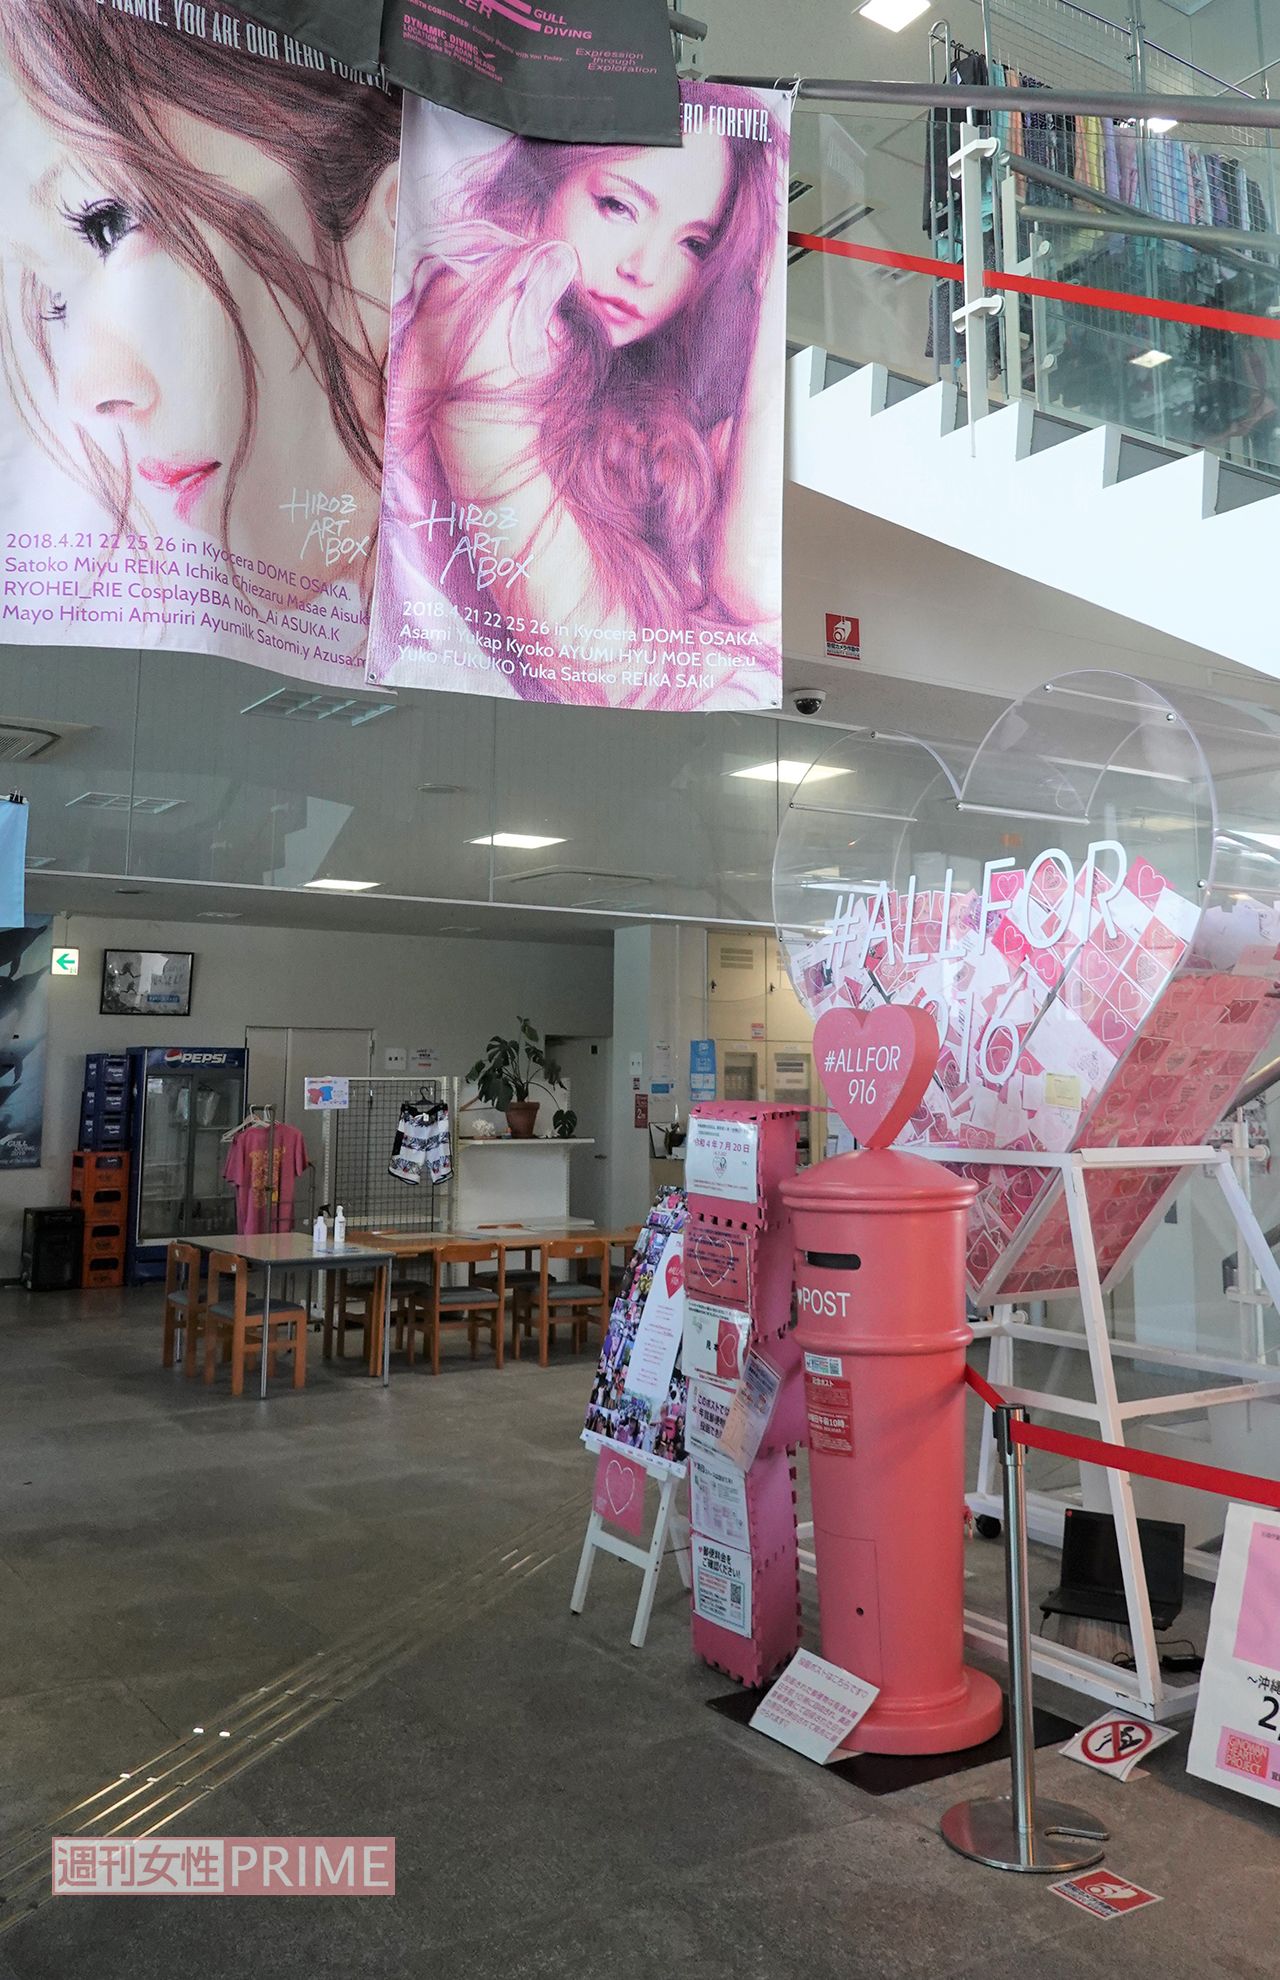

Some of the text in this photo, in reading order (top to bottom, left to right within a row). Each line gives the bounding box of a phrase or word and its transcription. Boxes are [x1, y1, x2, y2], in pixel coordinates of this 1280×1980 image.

[174, 0, 206, 38] YOU
[212, 12, 241, 49] ARE
[246, 23, 279, 60] OUR
[533, 8, 567, 25] GULL
[543, 25, 593, 40] DIVING
[403, 24, 438, 43] LOCATION
[403, 14, 479, 55] DYNAMIC DIVING
[575, 48, 644, 60] Expression
[587, 63, 658, 74] Exploration
[592, 57, 637, 66] through
[709, 105, 773, 142] FOREVER.
[300, 519, 350, 560] ART
[325, 536, 370, 567] BOX
[6, 533, 351, 601] 2018.4.21 22 25 26 in Kyocera DOME OSAKA.
[440, 533, 509, 584] ART
[476, 556, 532, 591] BOX
[5, 557, 69, 573] Satoko
[74, 557, 118, 577] Miyu
[125, 558, 180, 576] REIKA
[186, 562, 229, 586] Ichika
[232, 574, 284, 605] Chiezaru
[287, 593, 327, 617] Masae
[4, 581, 340, 642] RYOHEI_RIE CosplayBBA Non_Ai ASUKA.K
[3, 605, 54, 625] Mayo
[60, 606, 123, 622] Hitomi
[128, 607, 196, 625] Amuriri
[200, 612, 255, 640] Ayumilk
[257, 629, 310, 660] Satomi.y
[400, 624, 451, 641] Asami
[457, 628, 502, 653] Yukap
[506, 637, 554, 657] Kyoko
[558, 647, 613, 662] AYUMI
[620, 649, 656, 665] HYU
[662, 653, 701, 667] MOE
[484, 612, 501, 628] 22
[506, 616, 526, 632] 25
[530, 620, 550, 635] 26
[554, 623, 569, 636] in
[574, 623, 636, 643] Kyocera
[642, 628, 694, 645] DOME
[699, 631, 763, 646] OSAKA.
[398, 645, 714, 689] Yuko FUKUKO Yuka Satoko REIKA SAKI
[181, 1053, 228, 1064] PEPSI
[824, 1045, 901, 1072] #ALLFOR
[847, 1079, 877, 1105] 916
[802, 1286, 851, 1318] POST
[1229, 1734, 1267, 1756] GINOWAN
[1226, 1755, 1261, 1774] PROJECT
